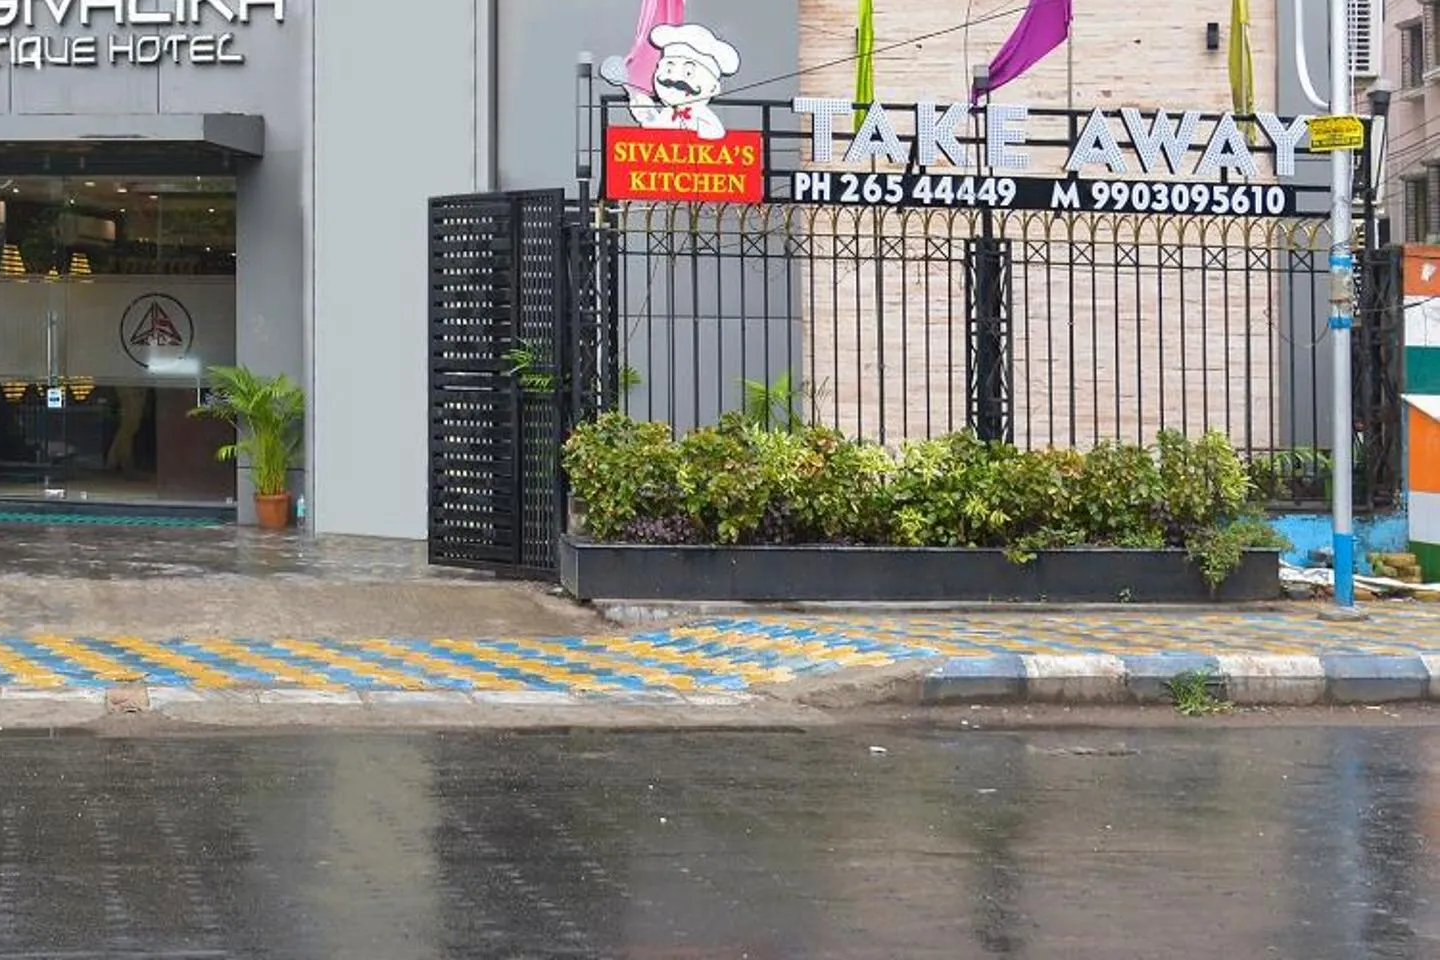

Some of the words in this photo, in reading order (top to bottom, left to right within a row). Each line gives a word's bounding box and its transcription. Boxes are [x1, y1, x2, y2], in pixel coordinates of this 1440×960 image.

[108, 32, 246, 66] HOTEL
[614, 141, 755, 166] SIVALIKA'S
[792, 96, 1033, 169] TAKE
[1064, 105, 1312, 177] AWAY
[630, 171, 745, 194] KITCHEN
[794, 171, 831, 202] PH
[840, 172, 904, 205] 265
[912, 176, 1017, 208] 44449
[1050, 181, 1081, 210] M
[1092, 180, 1286, 214] 9903095610
